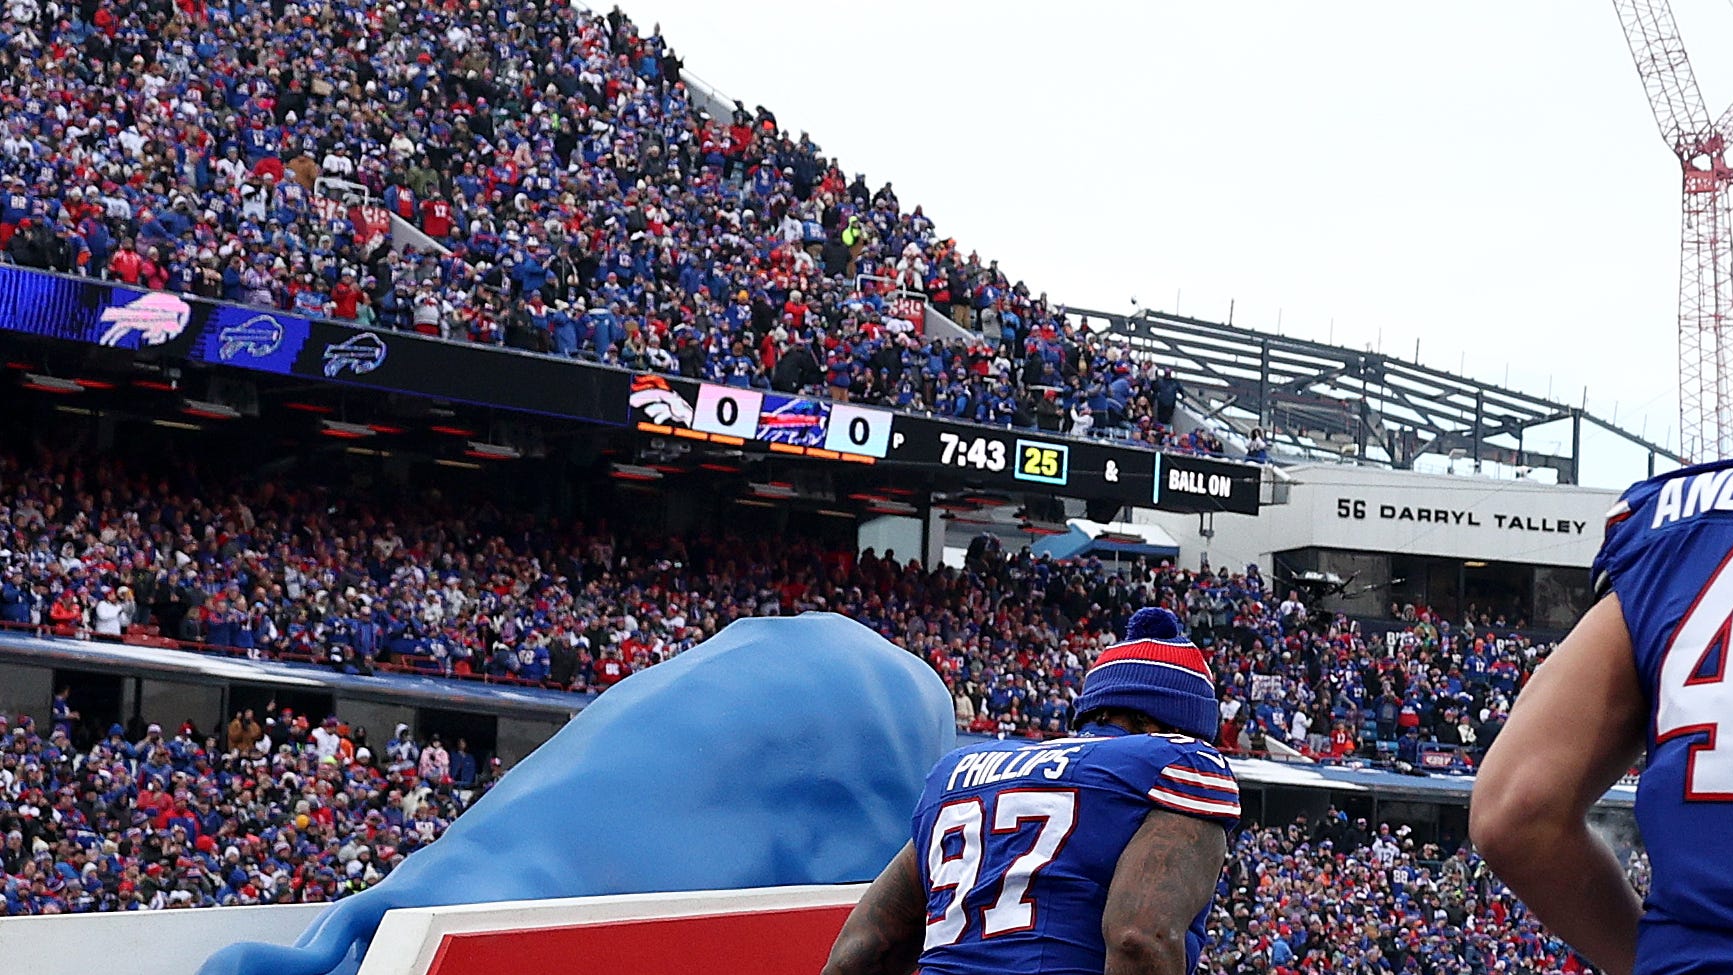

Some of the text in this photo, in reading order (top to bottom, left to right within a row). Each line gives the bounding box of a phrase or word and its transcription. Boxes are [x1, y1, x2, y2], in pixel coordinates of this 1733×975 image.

[716, 395, 738, 427] 0
[849, 415, 870, 446] 0
[893, 432, 905, 449] P
[940, 432, 1006, 472] 7:43
[1024, 447, 1058, 476] 25
[1169, 469, 1206, 495] BALL
[1208, 473, 1231, 498] ON
[1337, 498, 1587, 535] 56 DARRYL TALLEY
[947, 744, 1084, 791] PHILLIPS
[923, 788, 1079, 953] 97
